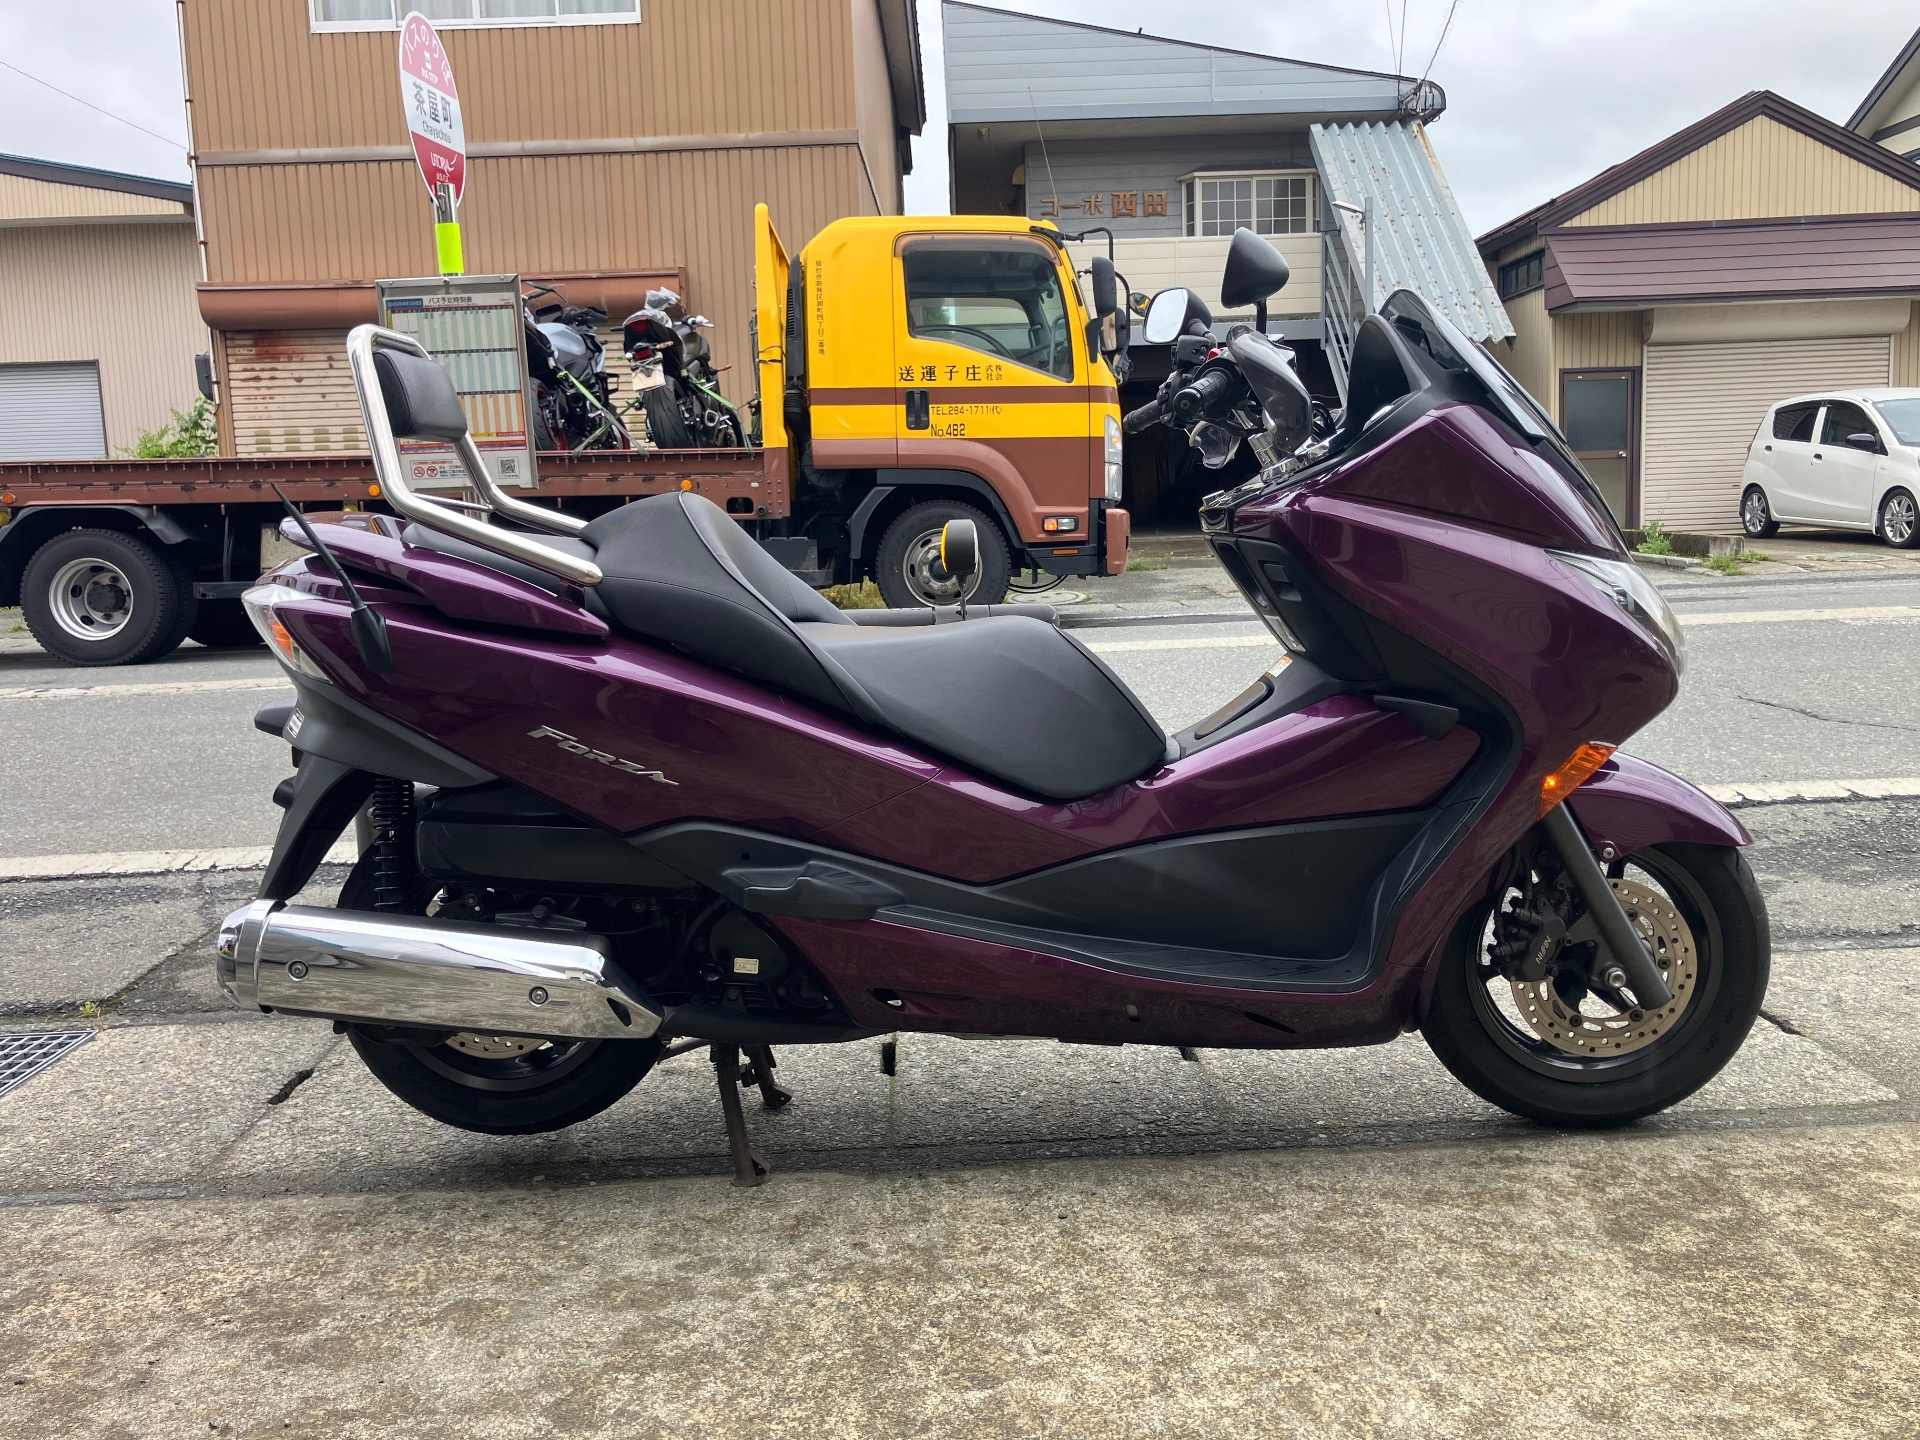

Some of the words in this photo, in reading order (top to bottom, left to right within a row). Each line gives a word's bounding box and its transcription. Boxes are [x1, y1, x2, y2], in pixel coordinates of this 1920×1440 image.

[412, 80, 453, 130] 茶屋町
[422, 120, 452, 144] Chayachou
[1040, 190, 1168, 218] コーポ西田
[930, 423, 966, 437] No.482
[526, 724, 680, 786] FORZA
